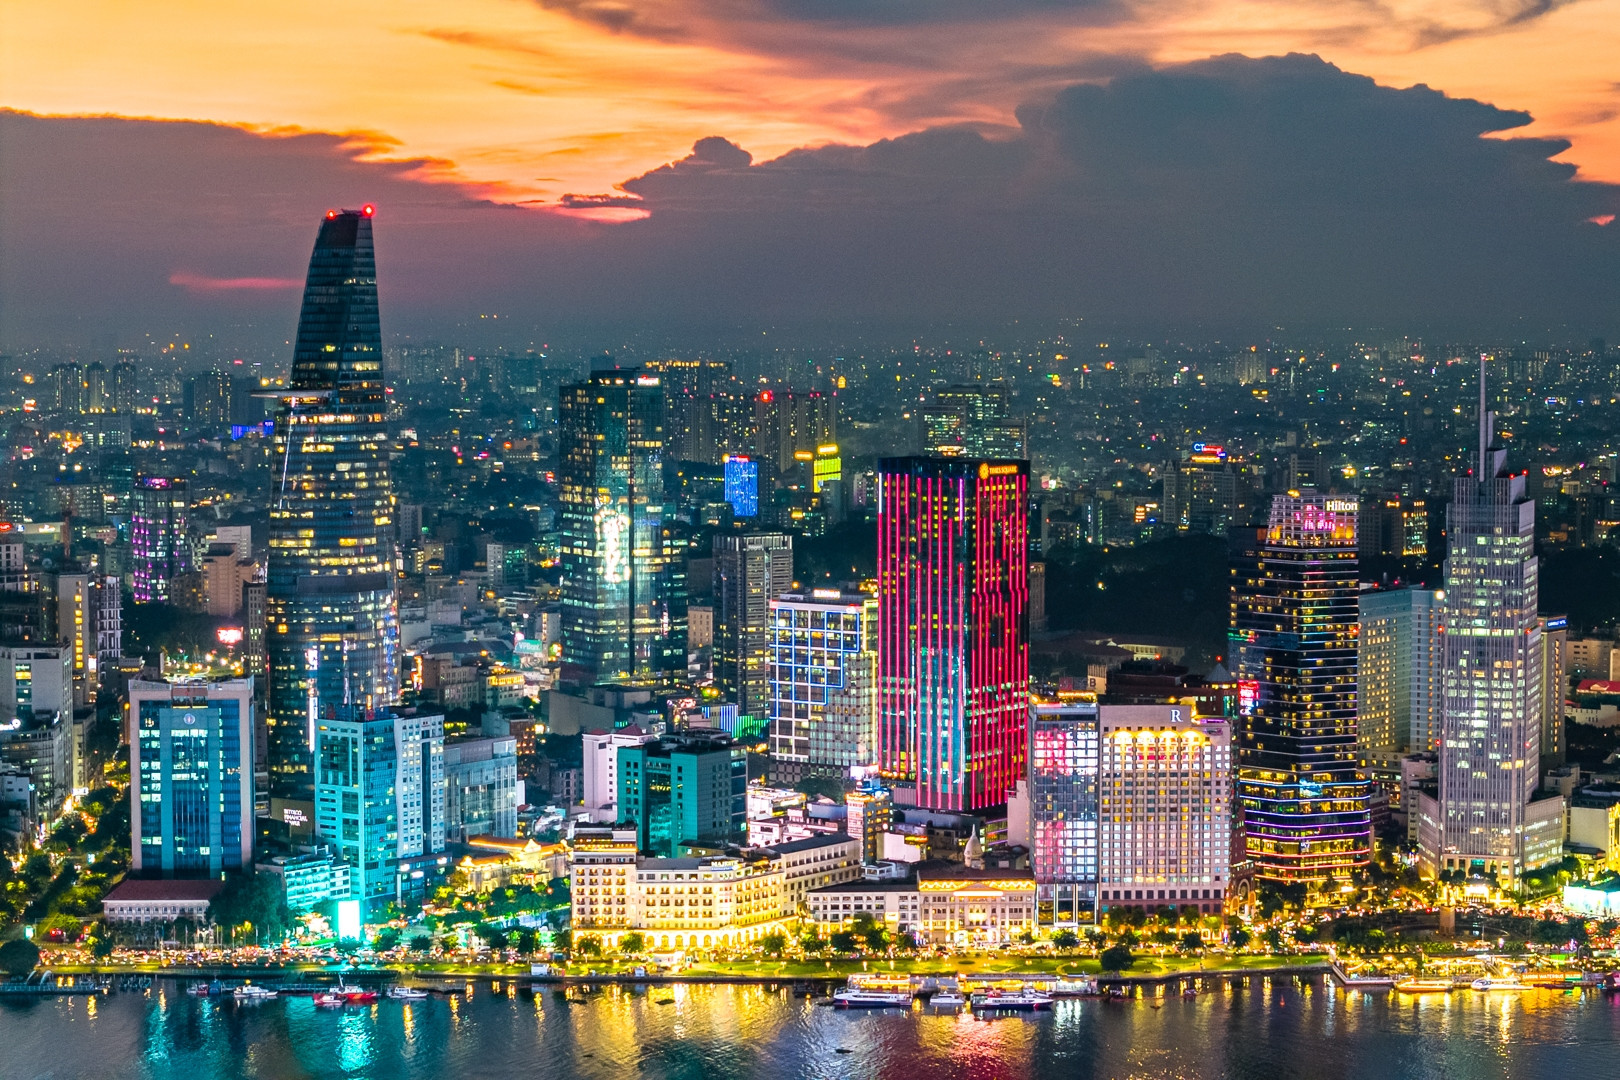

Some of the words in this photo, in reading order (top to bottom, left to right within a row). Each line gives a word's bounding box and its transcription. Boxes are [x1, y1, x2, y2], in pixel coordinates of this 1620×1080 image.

[1001, 465, 1018, 474] SQUARE
[1326, 500, 1358, 511] Hilton
[1089, 678, 1096, 687] B
[1172, 709, 1183, 723] R
